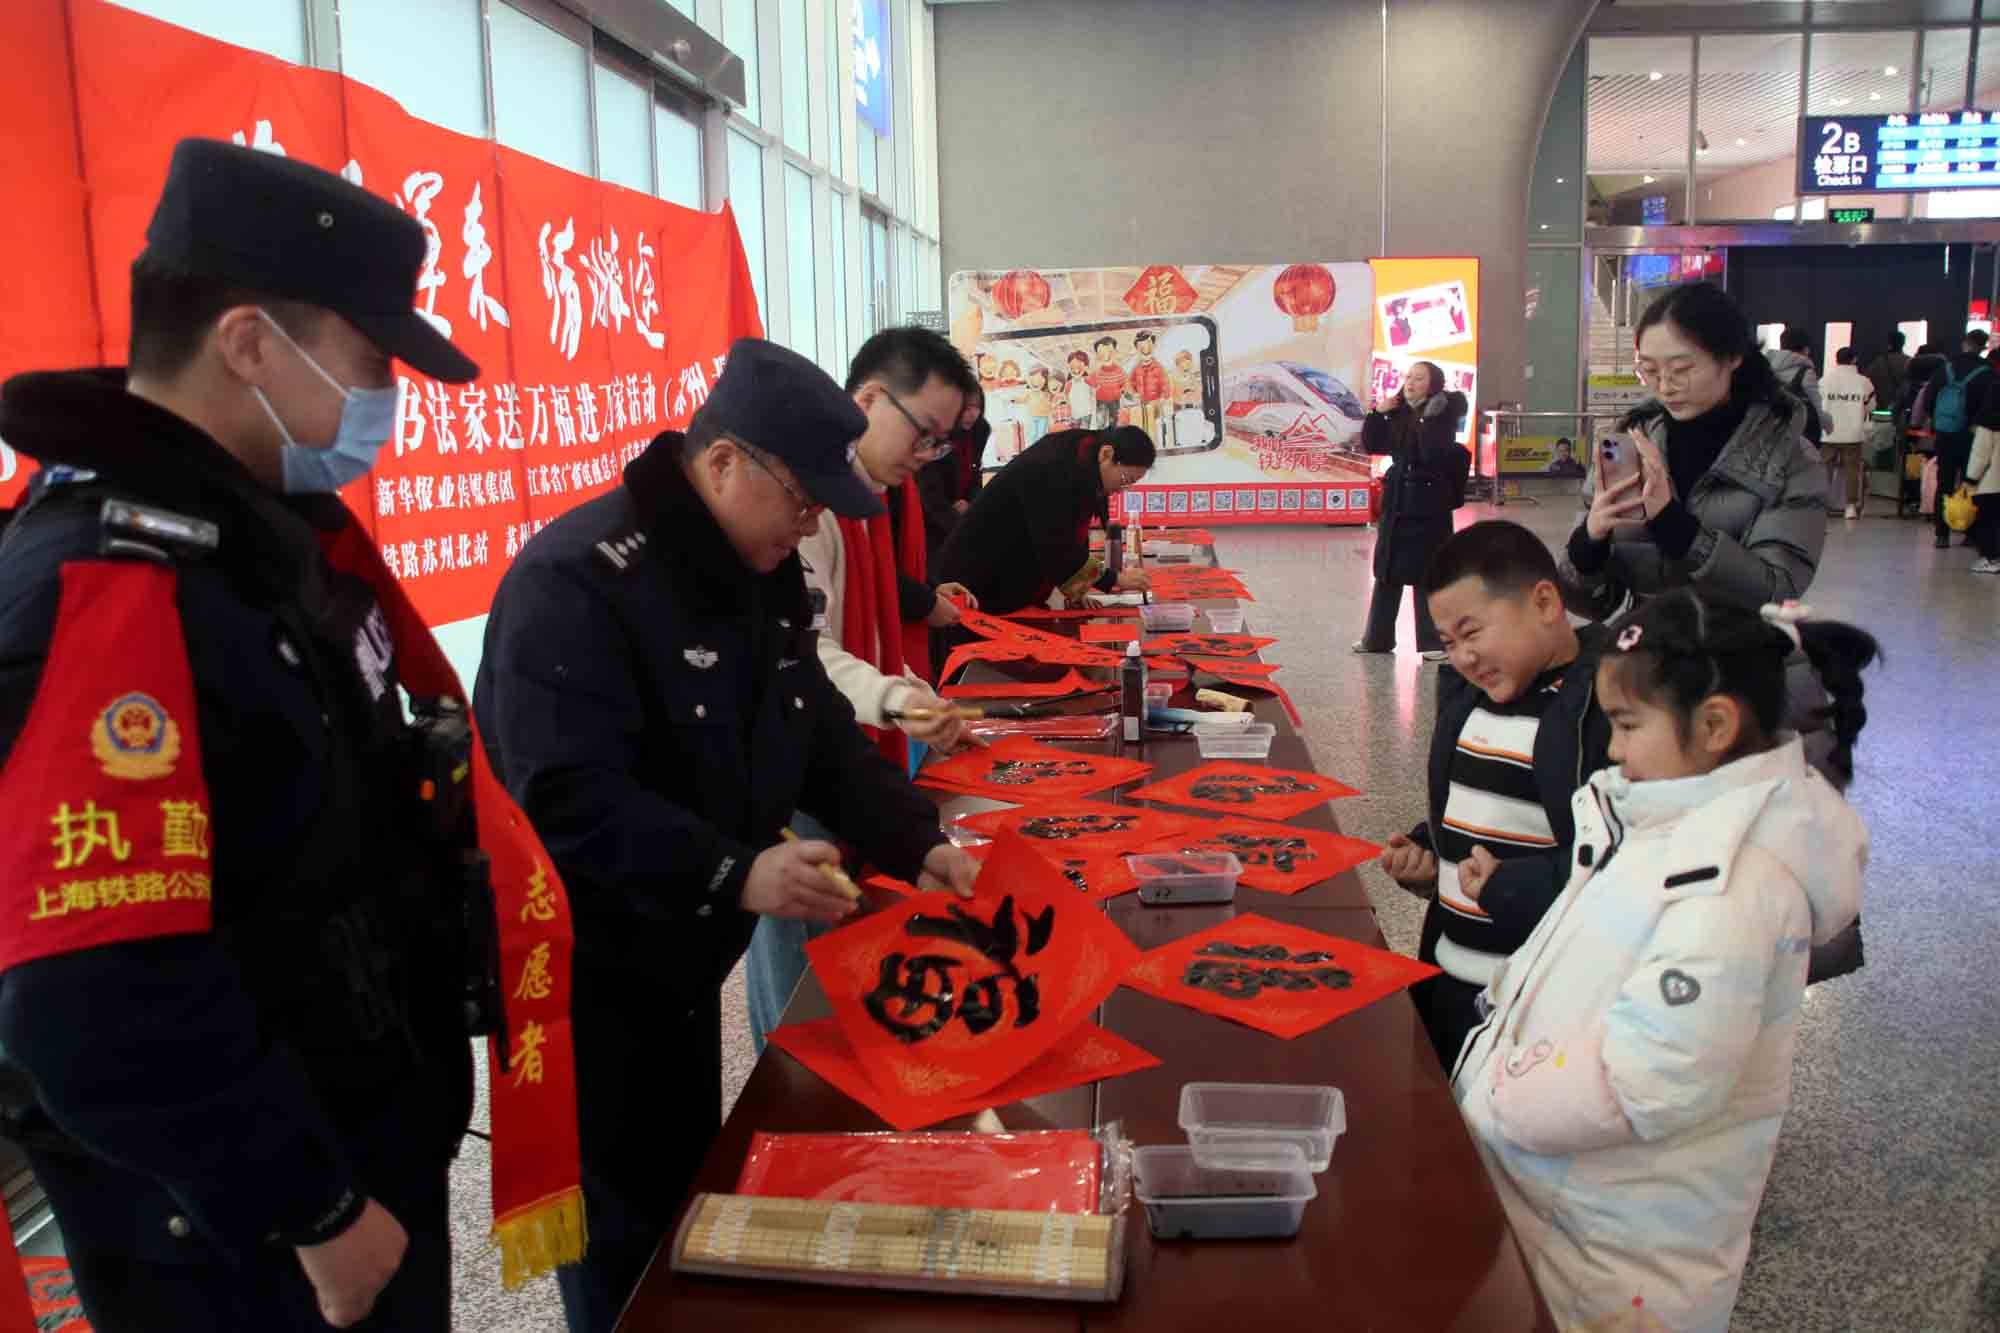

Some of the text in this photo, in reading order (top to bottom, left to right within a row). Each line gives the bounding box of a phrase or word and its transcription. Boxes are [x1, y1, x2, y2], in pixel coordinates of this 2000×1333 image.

[1821, 122, 1861, 154] 2B
[1814, 155, 1868, 175] 检票口
[1146, 271, 1178, 314] 福
[376, 468, 515, 516] 新华报业传媒集团
[50, 800, 209, 870] 执勤
[510, 865, 556, 1088] 志愿者
